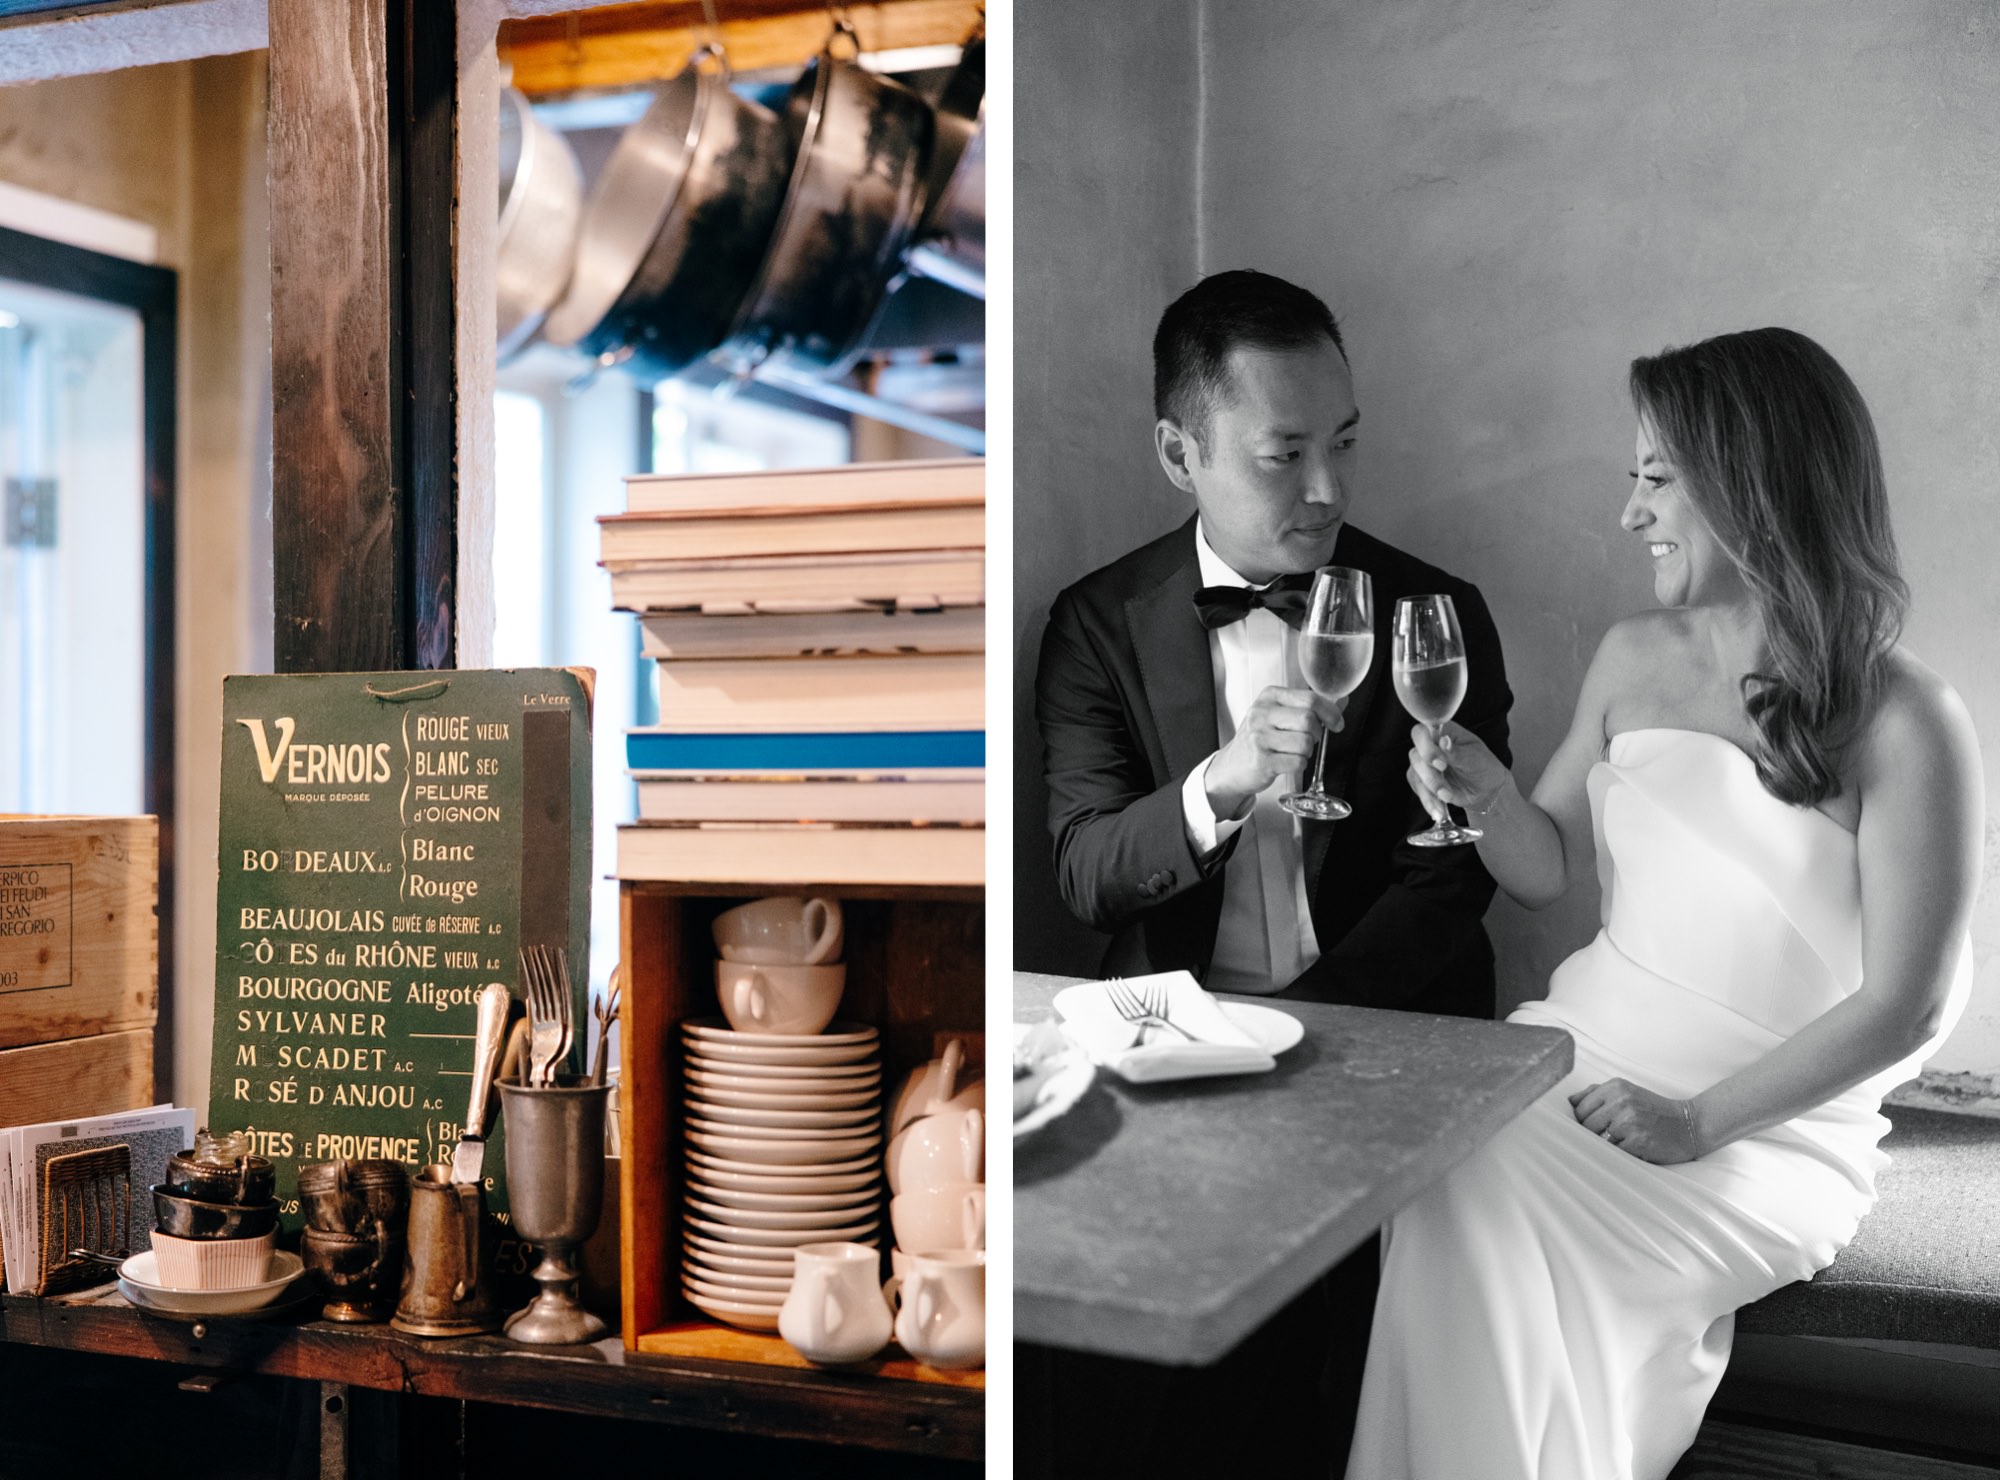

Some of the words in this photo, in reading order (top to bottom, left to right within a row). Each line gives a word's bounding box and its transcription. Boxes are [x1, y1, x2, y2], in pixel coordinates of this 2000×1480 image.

[523, 694, 537, 705] Le
[541, 693, 571, 705] Verre
[417, 716, 470, 741] ROUGE
[476, 724, 510, 741] VIEUX
[236, 716, 391, 784] VERNOIS
[415, 751, 469, 776] BLANC
[476, 758, 499, 776] SEC
[285, 793, 326, 803] MARQUE
[415, 785, 489, 801] PELURE
[414, 806, 500, 823] d'OIGNON
[412, 838, 475, 862] Blanc
[13, 886, 47, 902] FEUDI
[410, 874, 479, 904] Rouge
[6, 904, 31, 920] SAN
[239, 907, 385, 933] BEAUJOLAIS
[392, 913, 422, 934] CUVÉE
[425, 917, 437, 932] de
[439, 913, 481, 935] RÉSERVE
[325, 949, 346, 966] du
[355, 940, 437, 969] RHÔNE
[444, 951, 478, 969] VIEUX
[238, 975, 392, 1003] BOURGOGNE
[406, 981, 484, 1012] Aligoté
[238, 1009, 386, 1038] SYLVANER
[232, 1125, 294, 1158] ÔTES
[317, 1133, 419, 1165] PROVENCE
